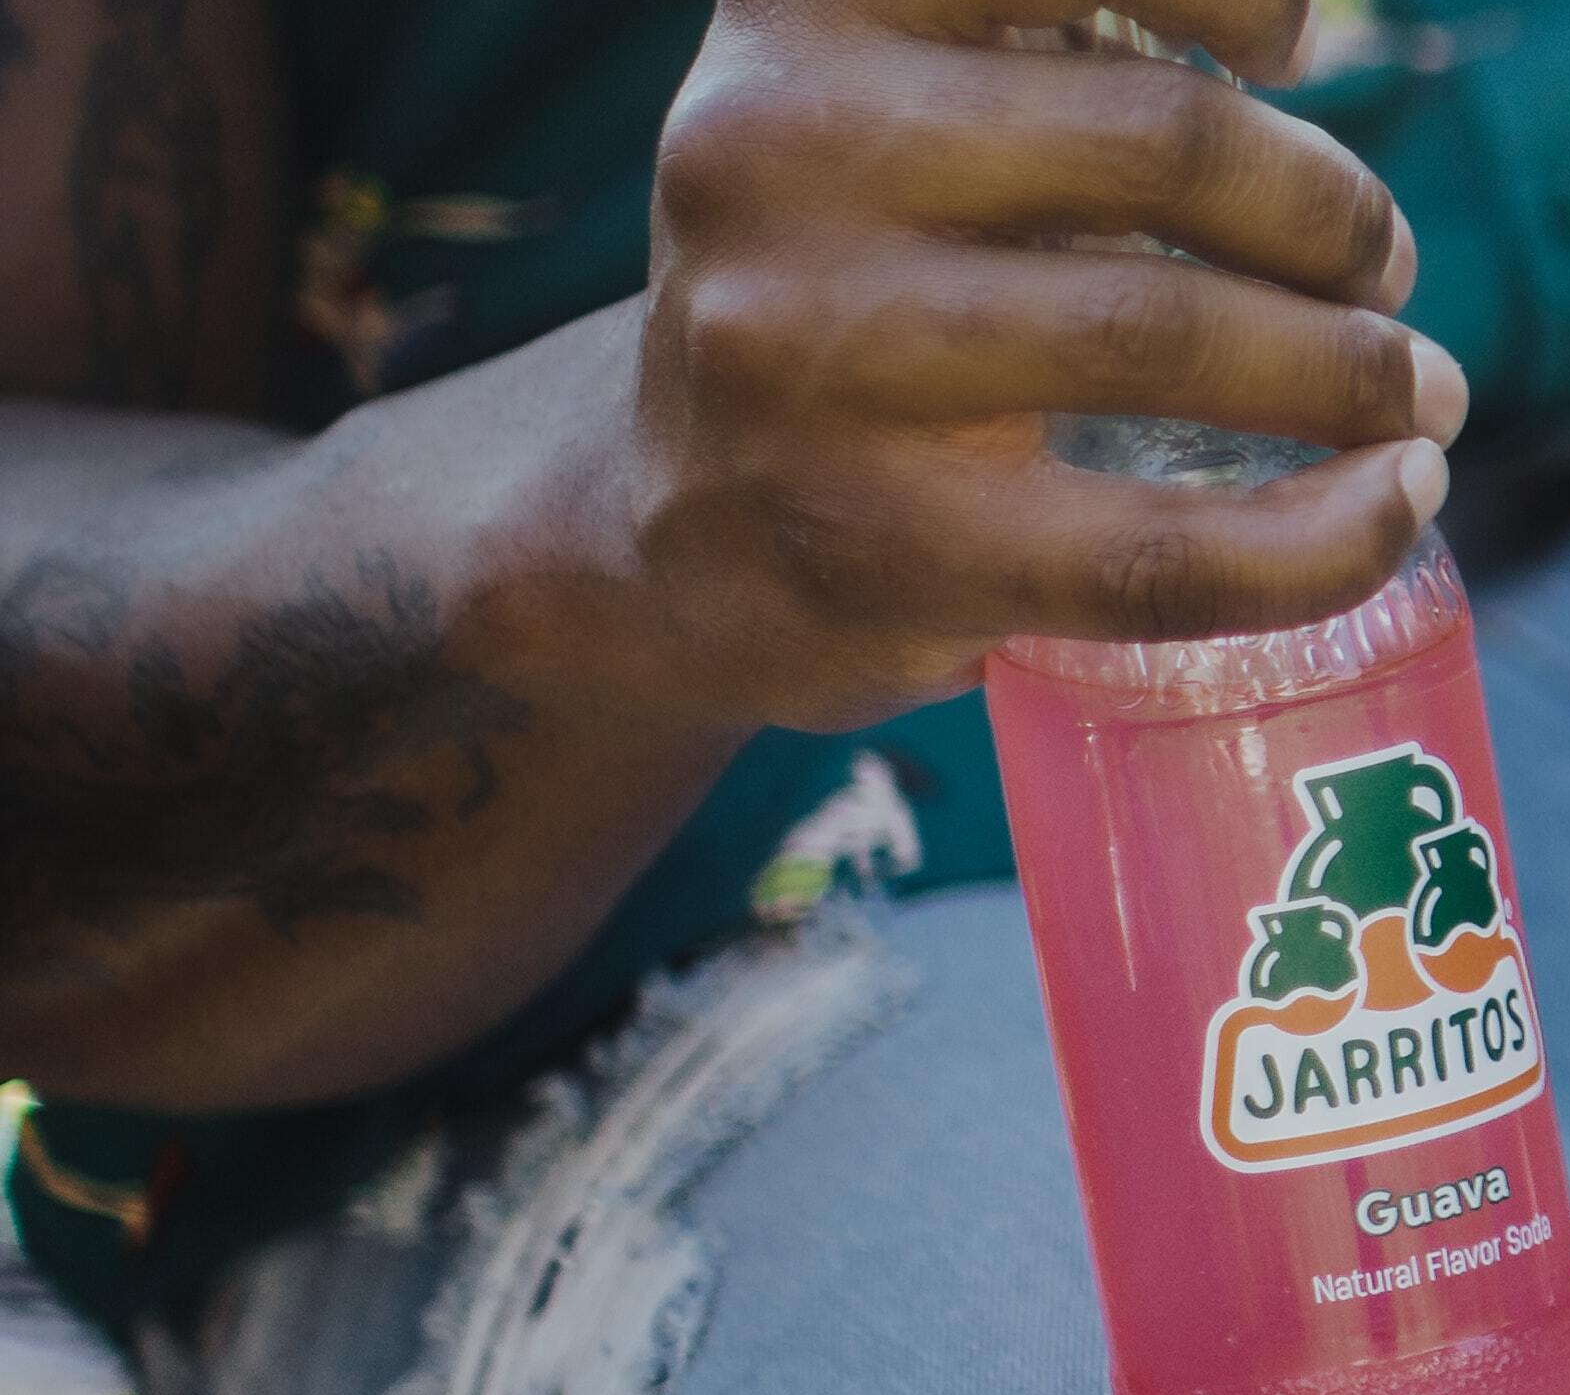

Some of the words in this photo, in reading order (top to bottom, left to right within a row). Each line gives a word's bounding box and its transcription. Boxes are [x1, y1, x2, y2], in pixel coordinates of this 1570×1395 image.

[1243, 988, 1525, 1120] JARRITOS
[1356, 1166, 1510, 1237] Guava
[1312, 1255, 1422, 1304] Natural
[1426, 1236, 1502, 1282] Flavor
[1505, 1212, 1553, 1255] Soda
